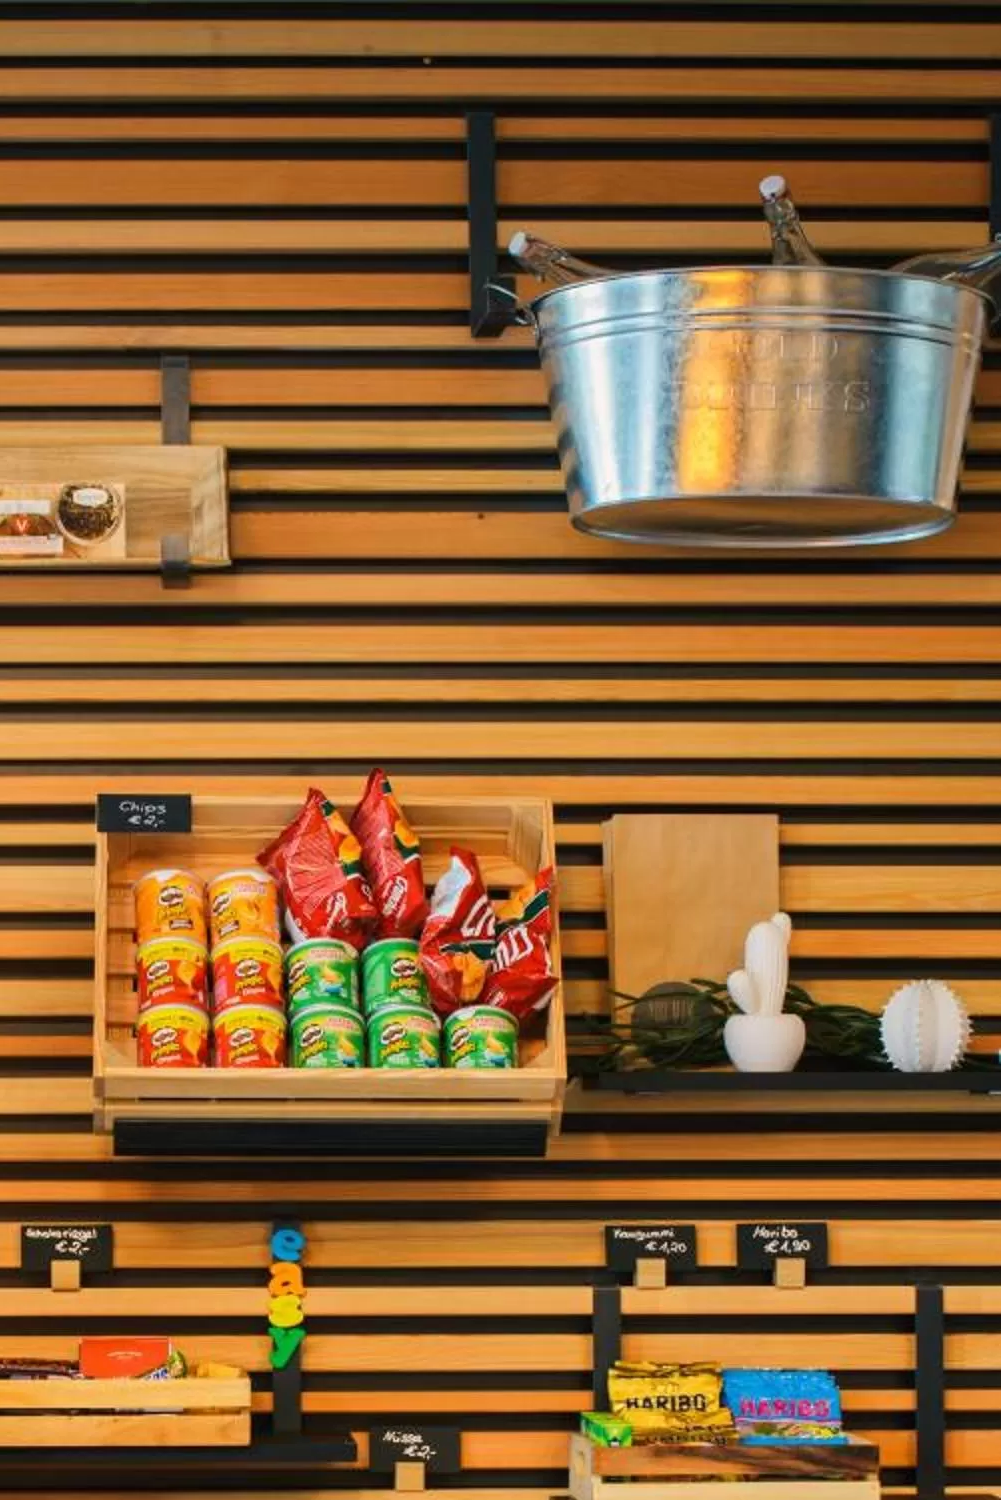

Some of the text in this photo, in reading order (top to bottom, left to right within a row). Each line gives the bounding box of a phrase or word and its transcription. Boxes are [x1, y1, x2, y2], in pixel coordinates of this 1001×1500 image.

[119, 800, 167, 816] Chips
[752, 1225, 799, 1239] Haribo
[625, 1394, 707, 1413] HARIBO
[739, 1399, 830, 1418] HARIBO
